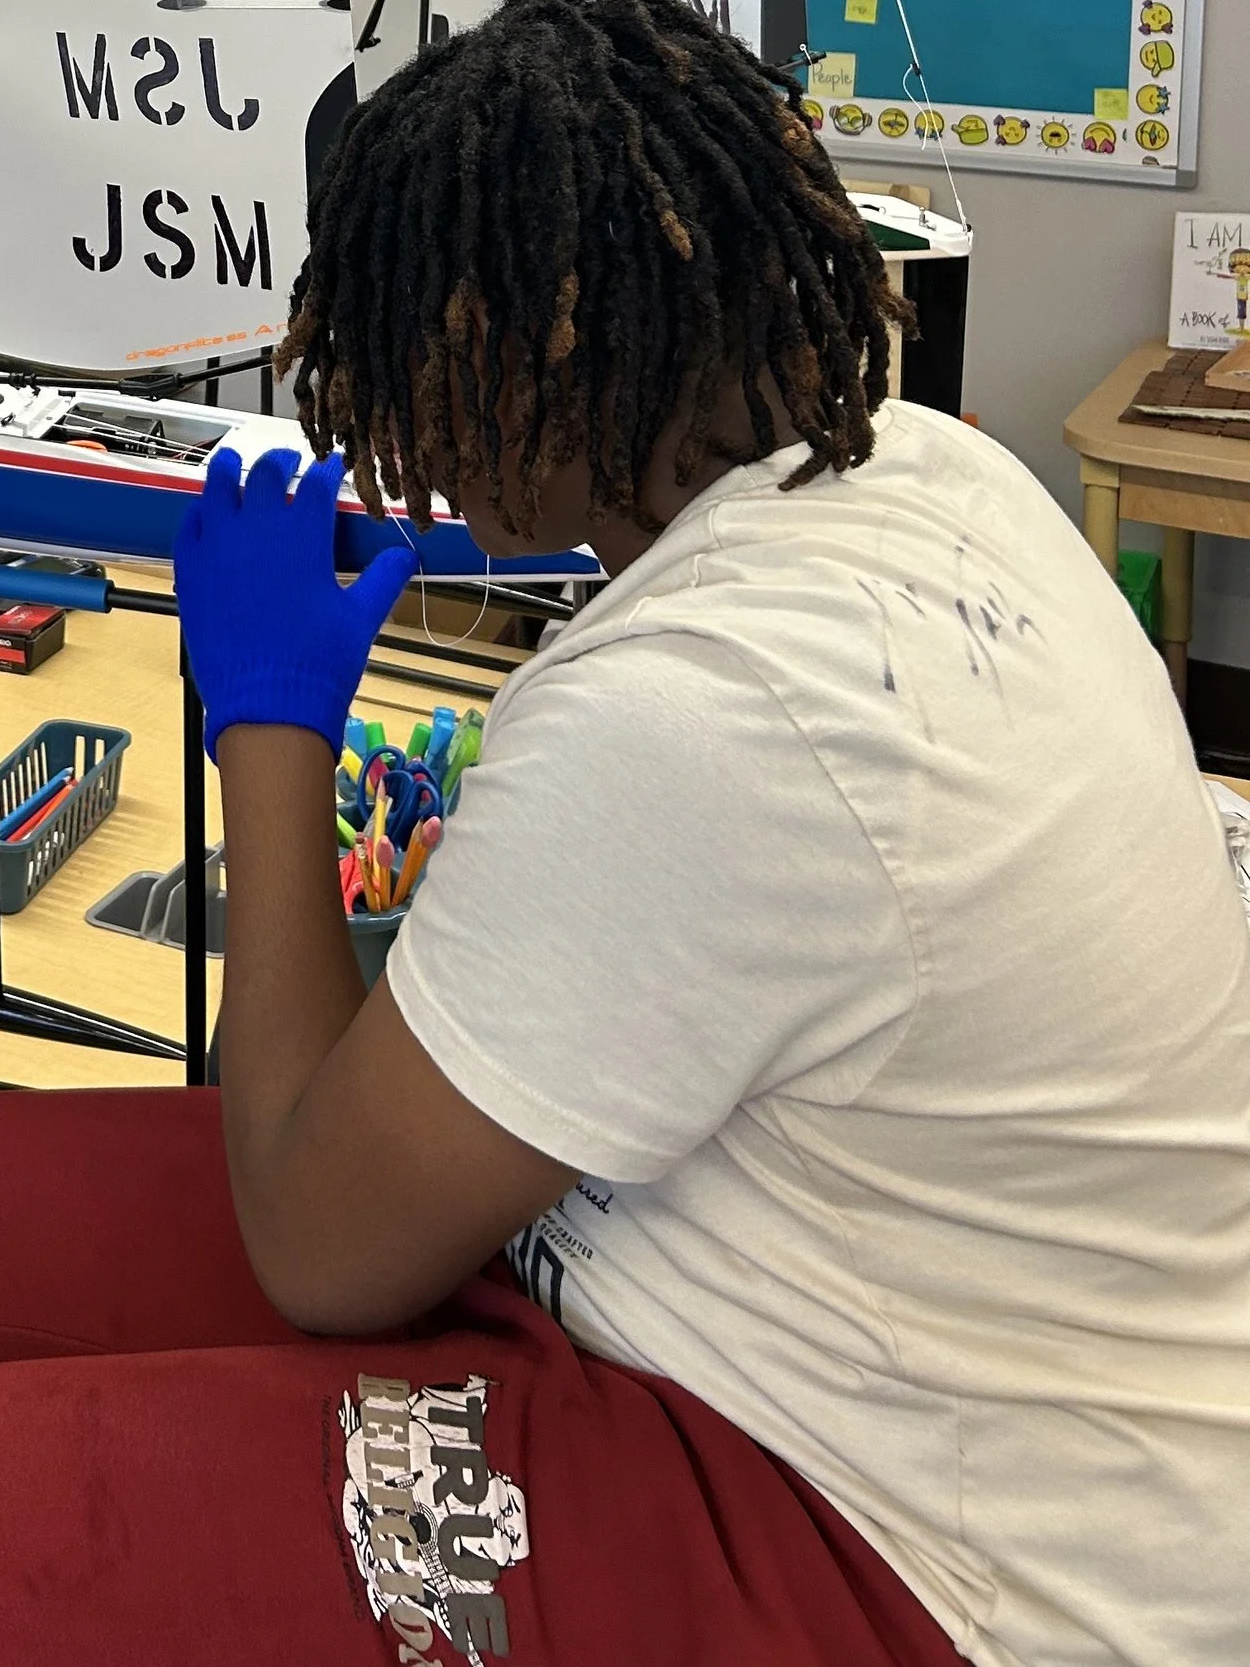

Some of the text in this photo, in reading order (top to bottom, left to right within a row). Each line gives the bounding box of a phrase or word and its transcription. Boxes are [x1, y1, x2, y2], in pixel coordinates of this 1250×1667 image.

[812, 65, 853, 92] People
[72, 183, 273, 291] JSM
[1185, 219, 1242, 249] I AM
[1180, 312, 1189, 327] A
[1192, 311, 1216, 328] BOOK
[428, 1396, 510, 1658] TRUE
